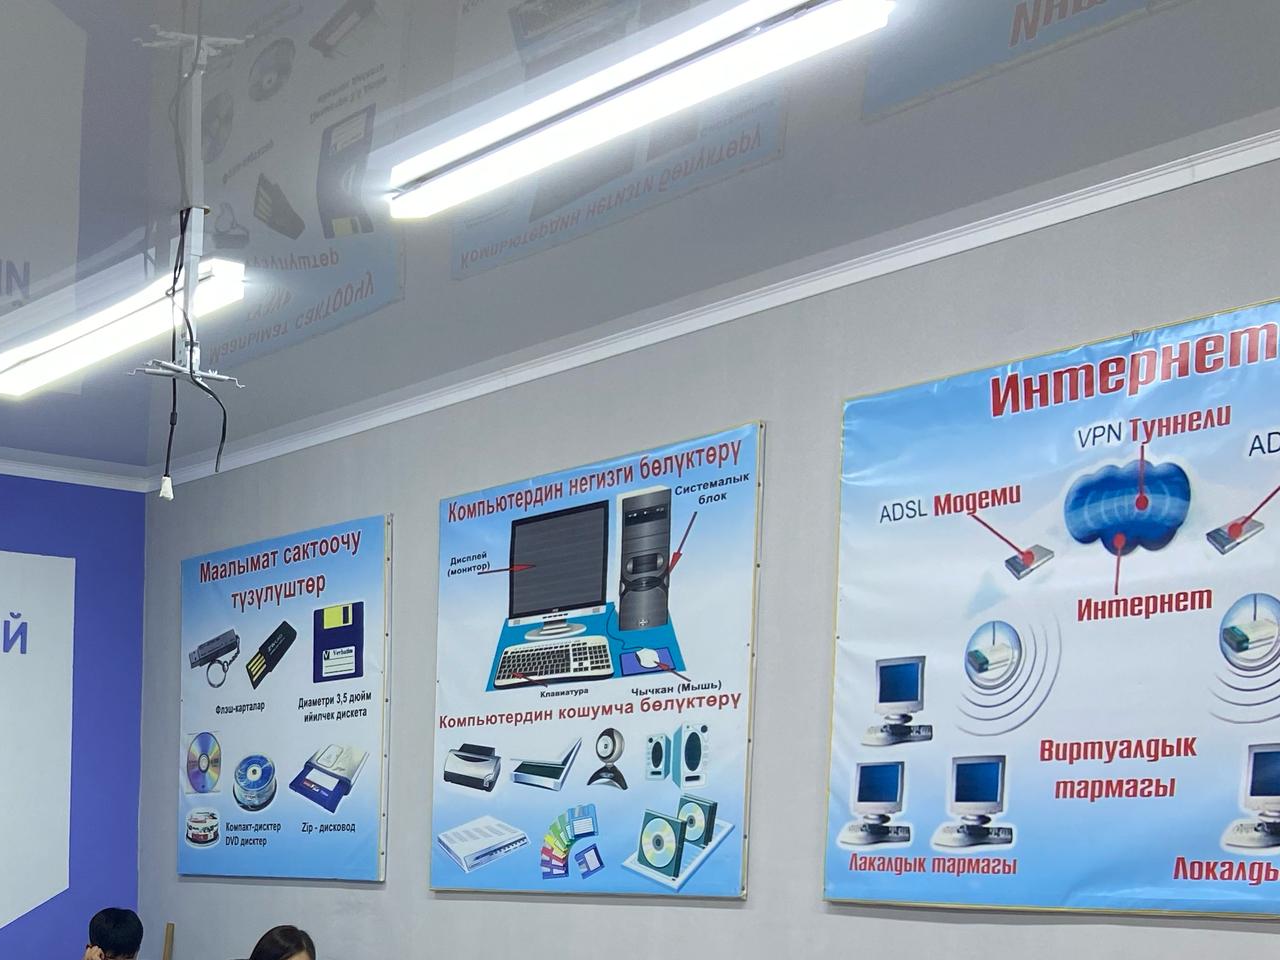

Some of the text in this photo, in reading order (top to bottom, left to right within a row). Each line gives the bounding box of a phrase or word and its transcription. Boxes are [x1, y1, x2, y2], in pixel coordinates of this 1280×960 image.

[990, 320, 1278, 419] Интернет
[1077, 405, 1232, 448] VPN Туннели
[447, 439, 742, 523] Компьютердин негизги бөлүктөрү
[674, 473, 750, 496] Системалык
[698, 490, 728, 506] блок
[880, 484, 1021, 524] ADSL Модеми
[200, 529, 362, 583] Маалымат сактоочу
[450, 552, 487, 566] Дисплей
[447, 562, 490, 577] (монитор)
[231, 573, 326, 613] түзүлүштөр
[1077, 587, 1213, 621] Интернет
[349, 690, 372, 704] дюйм
[540, 687, 589, 698] Клавиатура
[631, 680, 722, 697] Чычкан (Мышь)
[336, 708, 367, 720] дискета
[439, 692, 741, 729] Компьютердин кошумча бөлүктөрү
[1040, 735, 1197, 768] Виртуалдык
[1054, 776, 1176, 803] тармагы
[301, 822, 314, 834] Zip
[320, 823, 355, 833] дисковод
[225, 835, 238, 846] DVD
[931, 856, 1018, 877] тармагы
